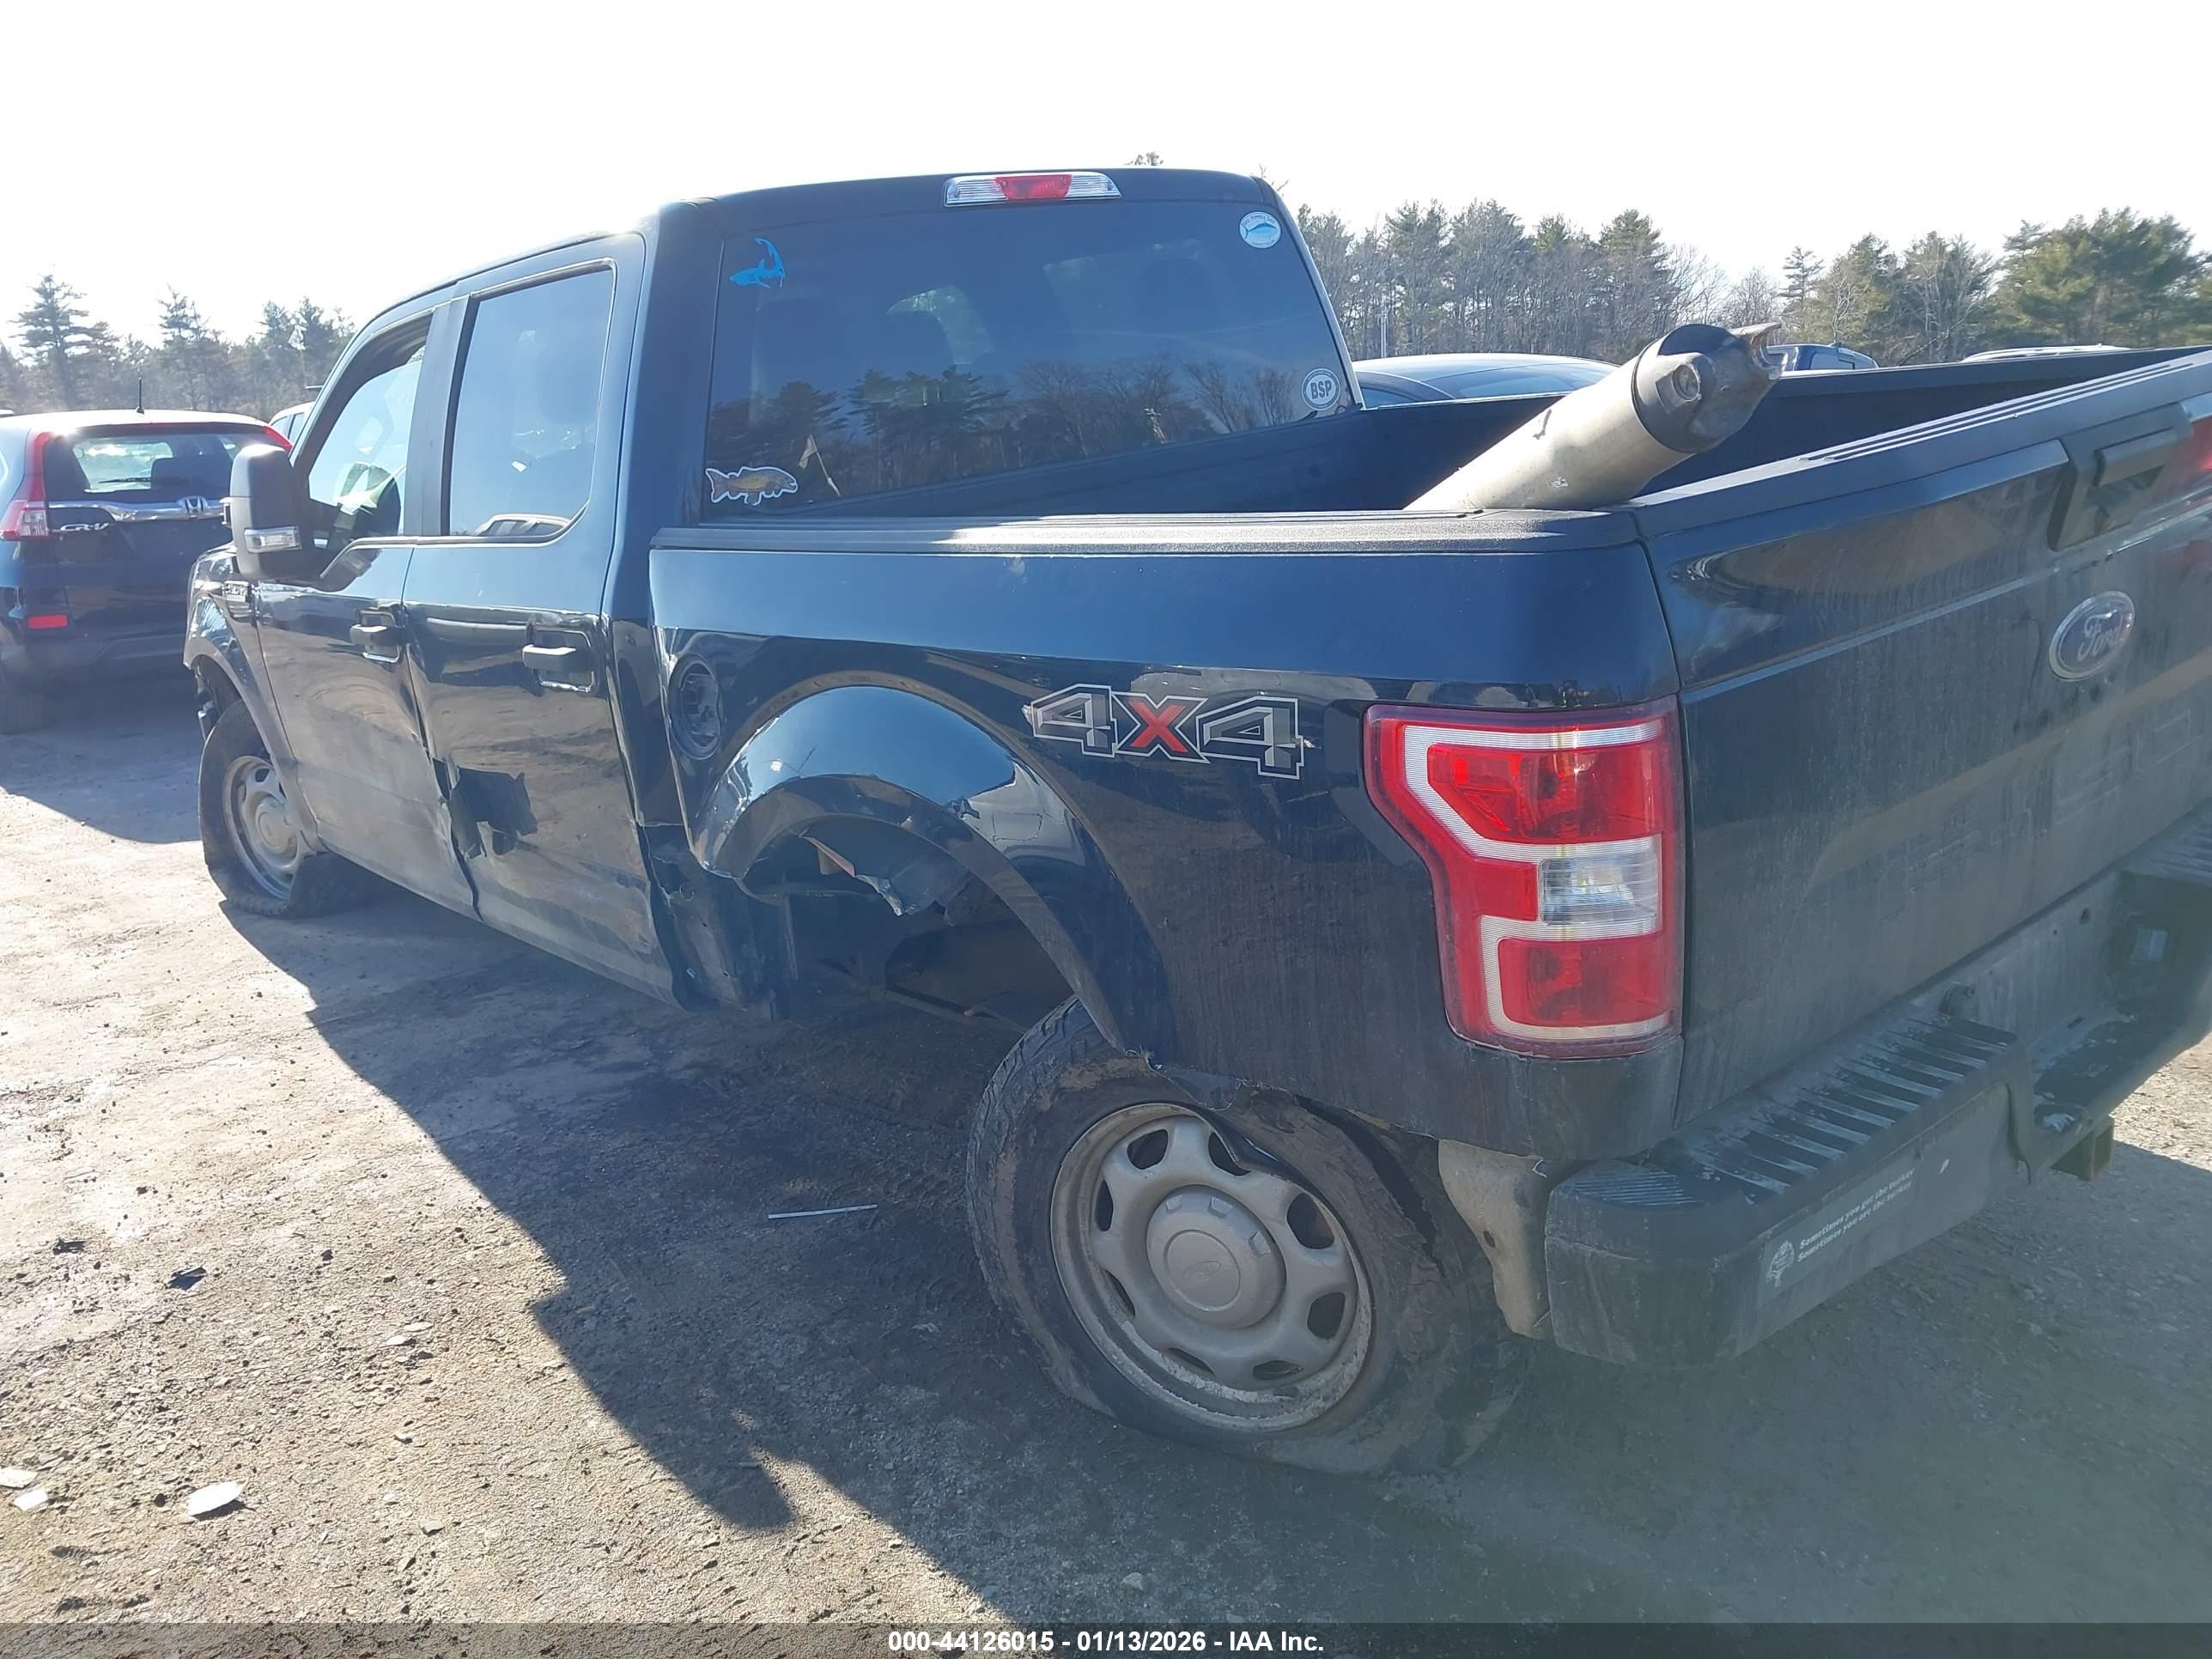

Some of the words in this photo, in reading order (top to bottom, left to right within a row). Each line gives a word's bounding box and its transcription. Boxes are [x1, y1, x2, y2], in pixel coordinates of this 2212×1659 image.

[1310, 380, 1333, 400] BSP
[2076, 608, 2124, 662] Ford
[1797, 1228, 1842, 1262] Sometimes
[1799, 1216, 1844, 1250] Sometimes
